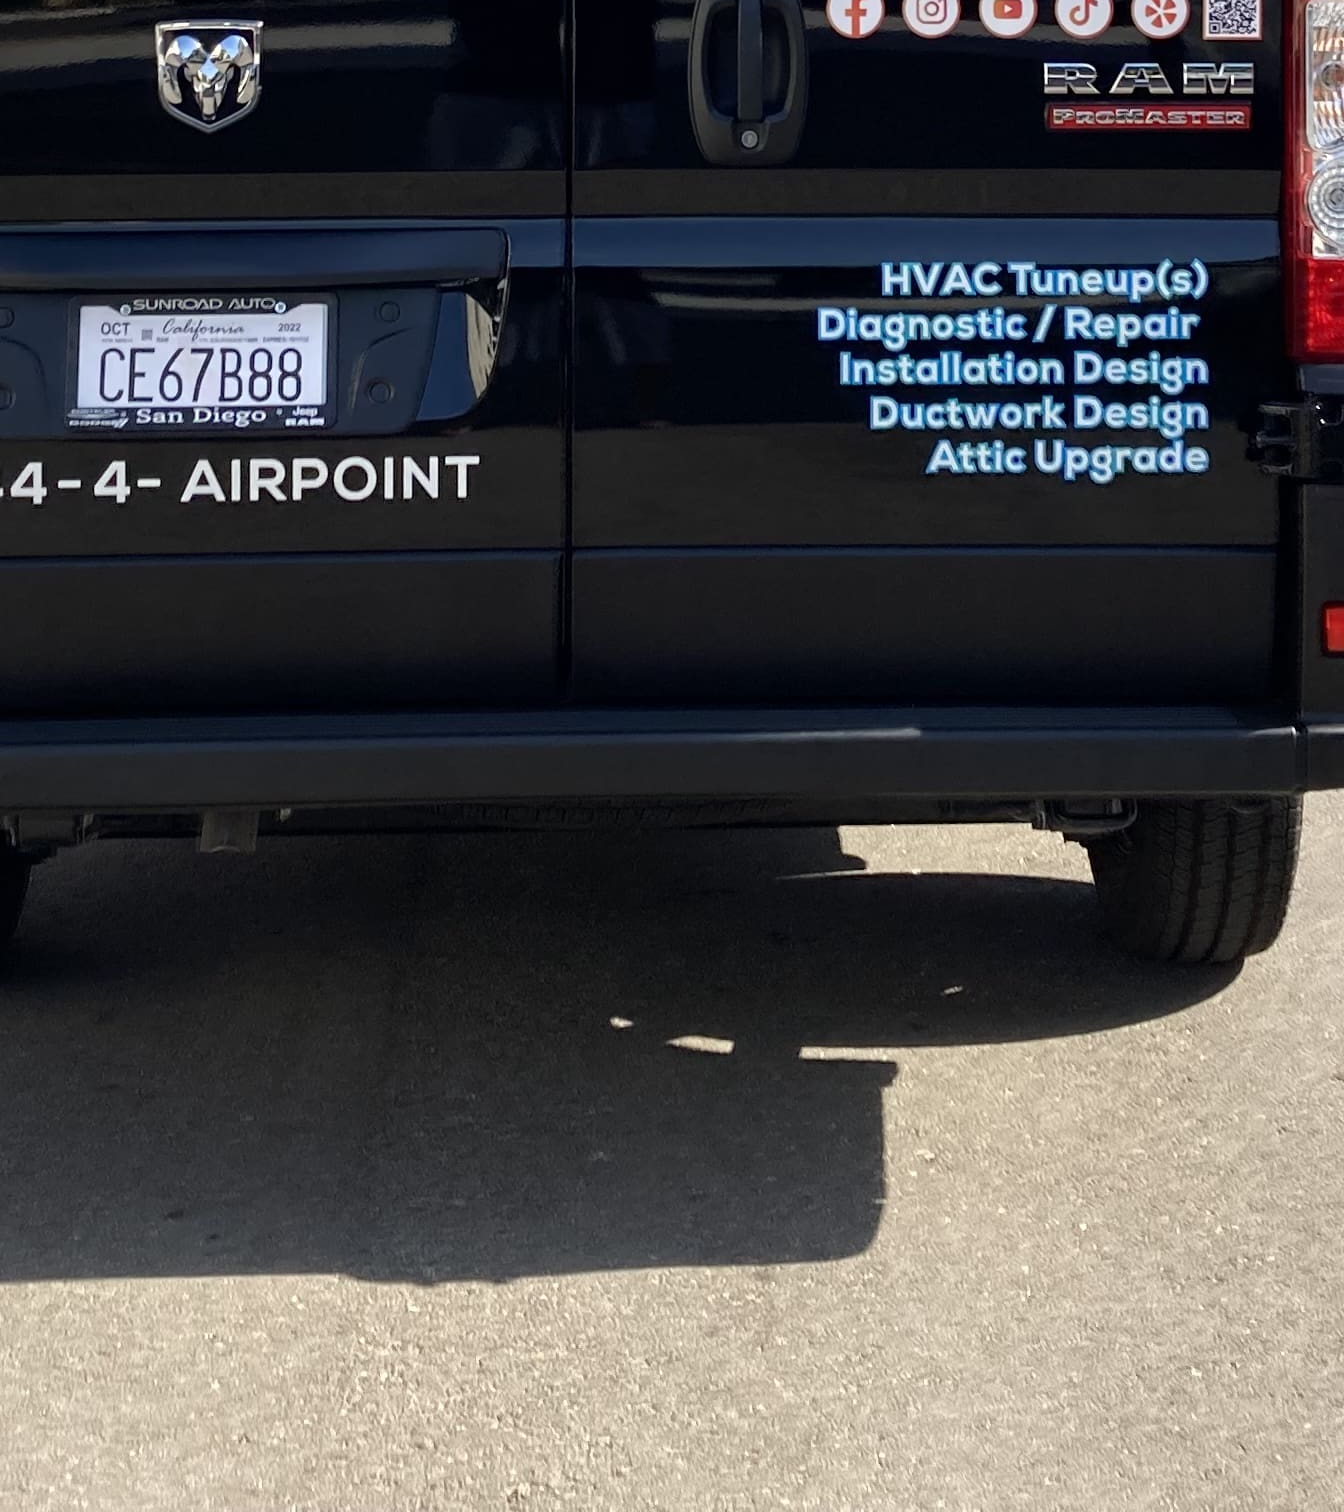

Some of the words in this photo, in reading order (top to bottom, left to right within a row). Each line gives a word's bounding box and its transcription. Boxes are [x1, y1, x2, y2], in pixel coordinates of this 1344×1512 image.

[1043, 62, 1255, 95] RAM
[880, 261, 1004, 296] HVAC
[1008, 258, 1209, 303] Tuneup(s)
[133, 298, 223, 311] SUNROAD
[228, 297, 276, 310] AUTO
[100, 322, 131, 336] OCT
[162, 318, 245, 342] California
[278, 323, 301, 333] 2022
[817, 306, 1027, 352] Diagnostic
[1064, 306, 1201, 348] Repair
[99, 348, 303, 403] CE67B88
[840, 351, 1065, 386] Installation
[1073, 351, 1209, 394] Design
[136, 408, 184, 425] San
[193, 406, 267, 428] Diego
[869, 395, 1067, 431] Ductwork
[1073, 395, 1209, 438] Design
[180, 455, 480, 504] AIRPOINT
[925, 438, 1027, 475] Attic
[1034, 438, 1209, 485] Upgrade
